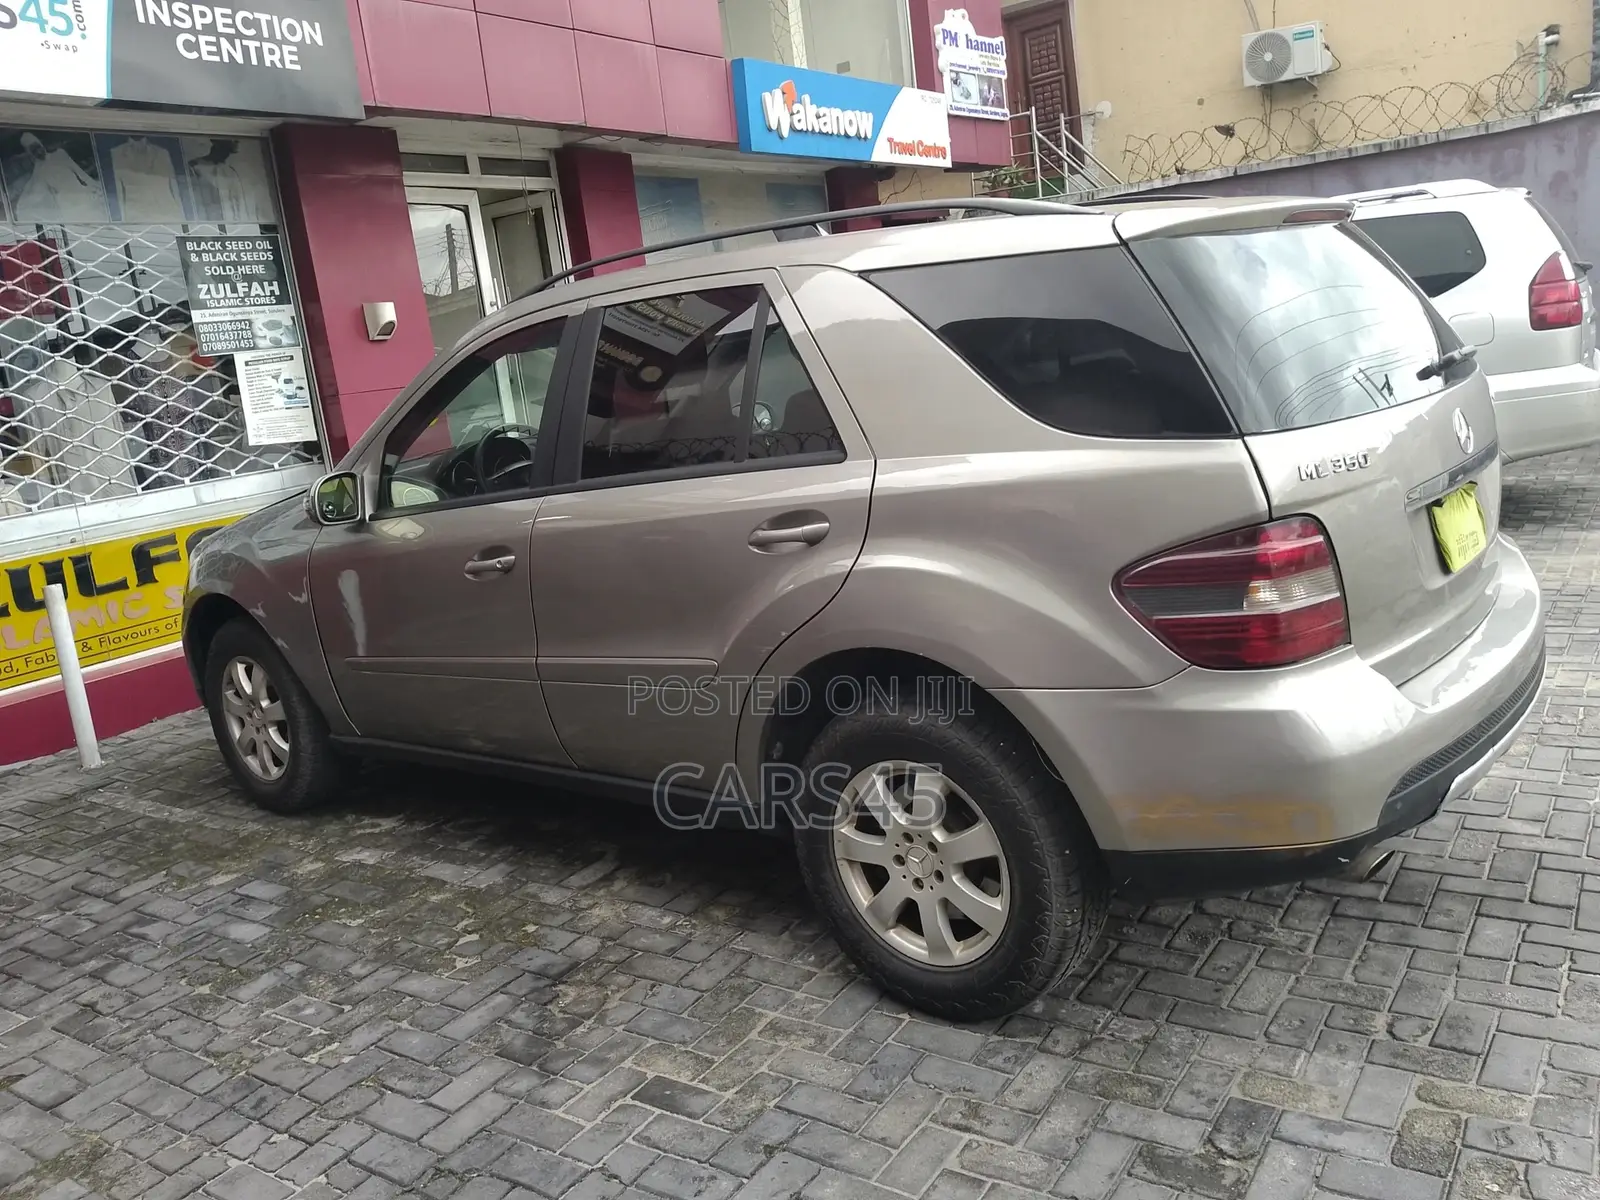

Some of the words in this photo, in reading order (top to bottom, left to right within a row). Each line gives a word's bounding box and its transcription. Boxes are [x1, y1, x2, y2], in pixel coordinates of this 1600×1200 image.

[134, 0, 323, 46] INSPECTION
[941, 28, 959, 48] PM
[176, 33, 302, 71] CENTRE
[762, 80, 874, 140] Wakanow
[887, 137, 916, 157] Travel
[916, 139, 947, 160] Centre
[186, 241, 223, 251] BLACK
[225, 241, 252, 250] SEED
[255, 240, 273, 250] OIL
[190, 252, 199, 262] &
[202, 252, 238, 262] BLACK
[240, 251, 274, 261] SEEDS
[204, 265, 235, 276] SOLD
[237, 264, 266, 275] HERE
[197, 281, 280, 300] ZULFAH
[206, 298, 243, 308] ISLAMIC
[244, 296, 277, 306] STORES
[198, 321, 251, 333] 08033066942
[202, 340, 254, 352] 07089501453
[1298, 462, 1329, 481] ML
[1330, 450, 1372, 474] 350
[0, 526, 226, 618] ULF
[0, 592, 151, 651] LAMIC
[24, 652, 57, 668] Fab
[81, 641, 94, 653] &
[98, 625, 160, 649] Flavours
[164, 617, 180, 631] of
